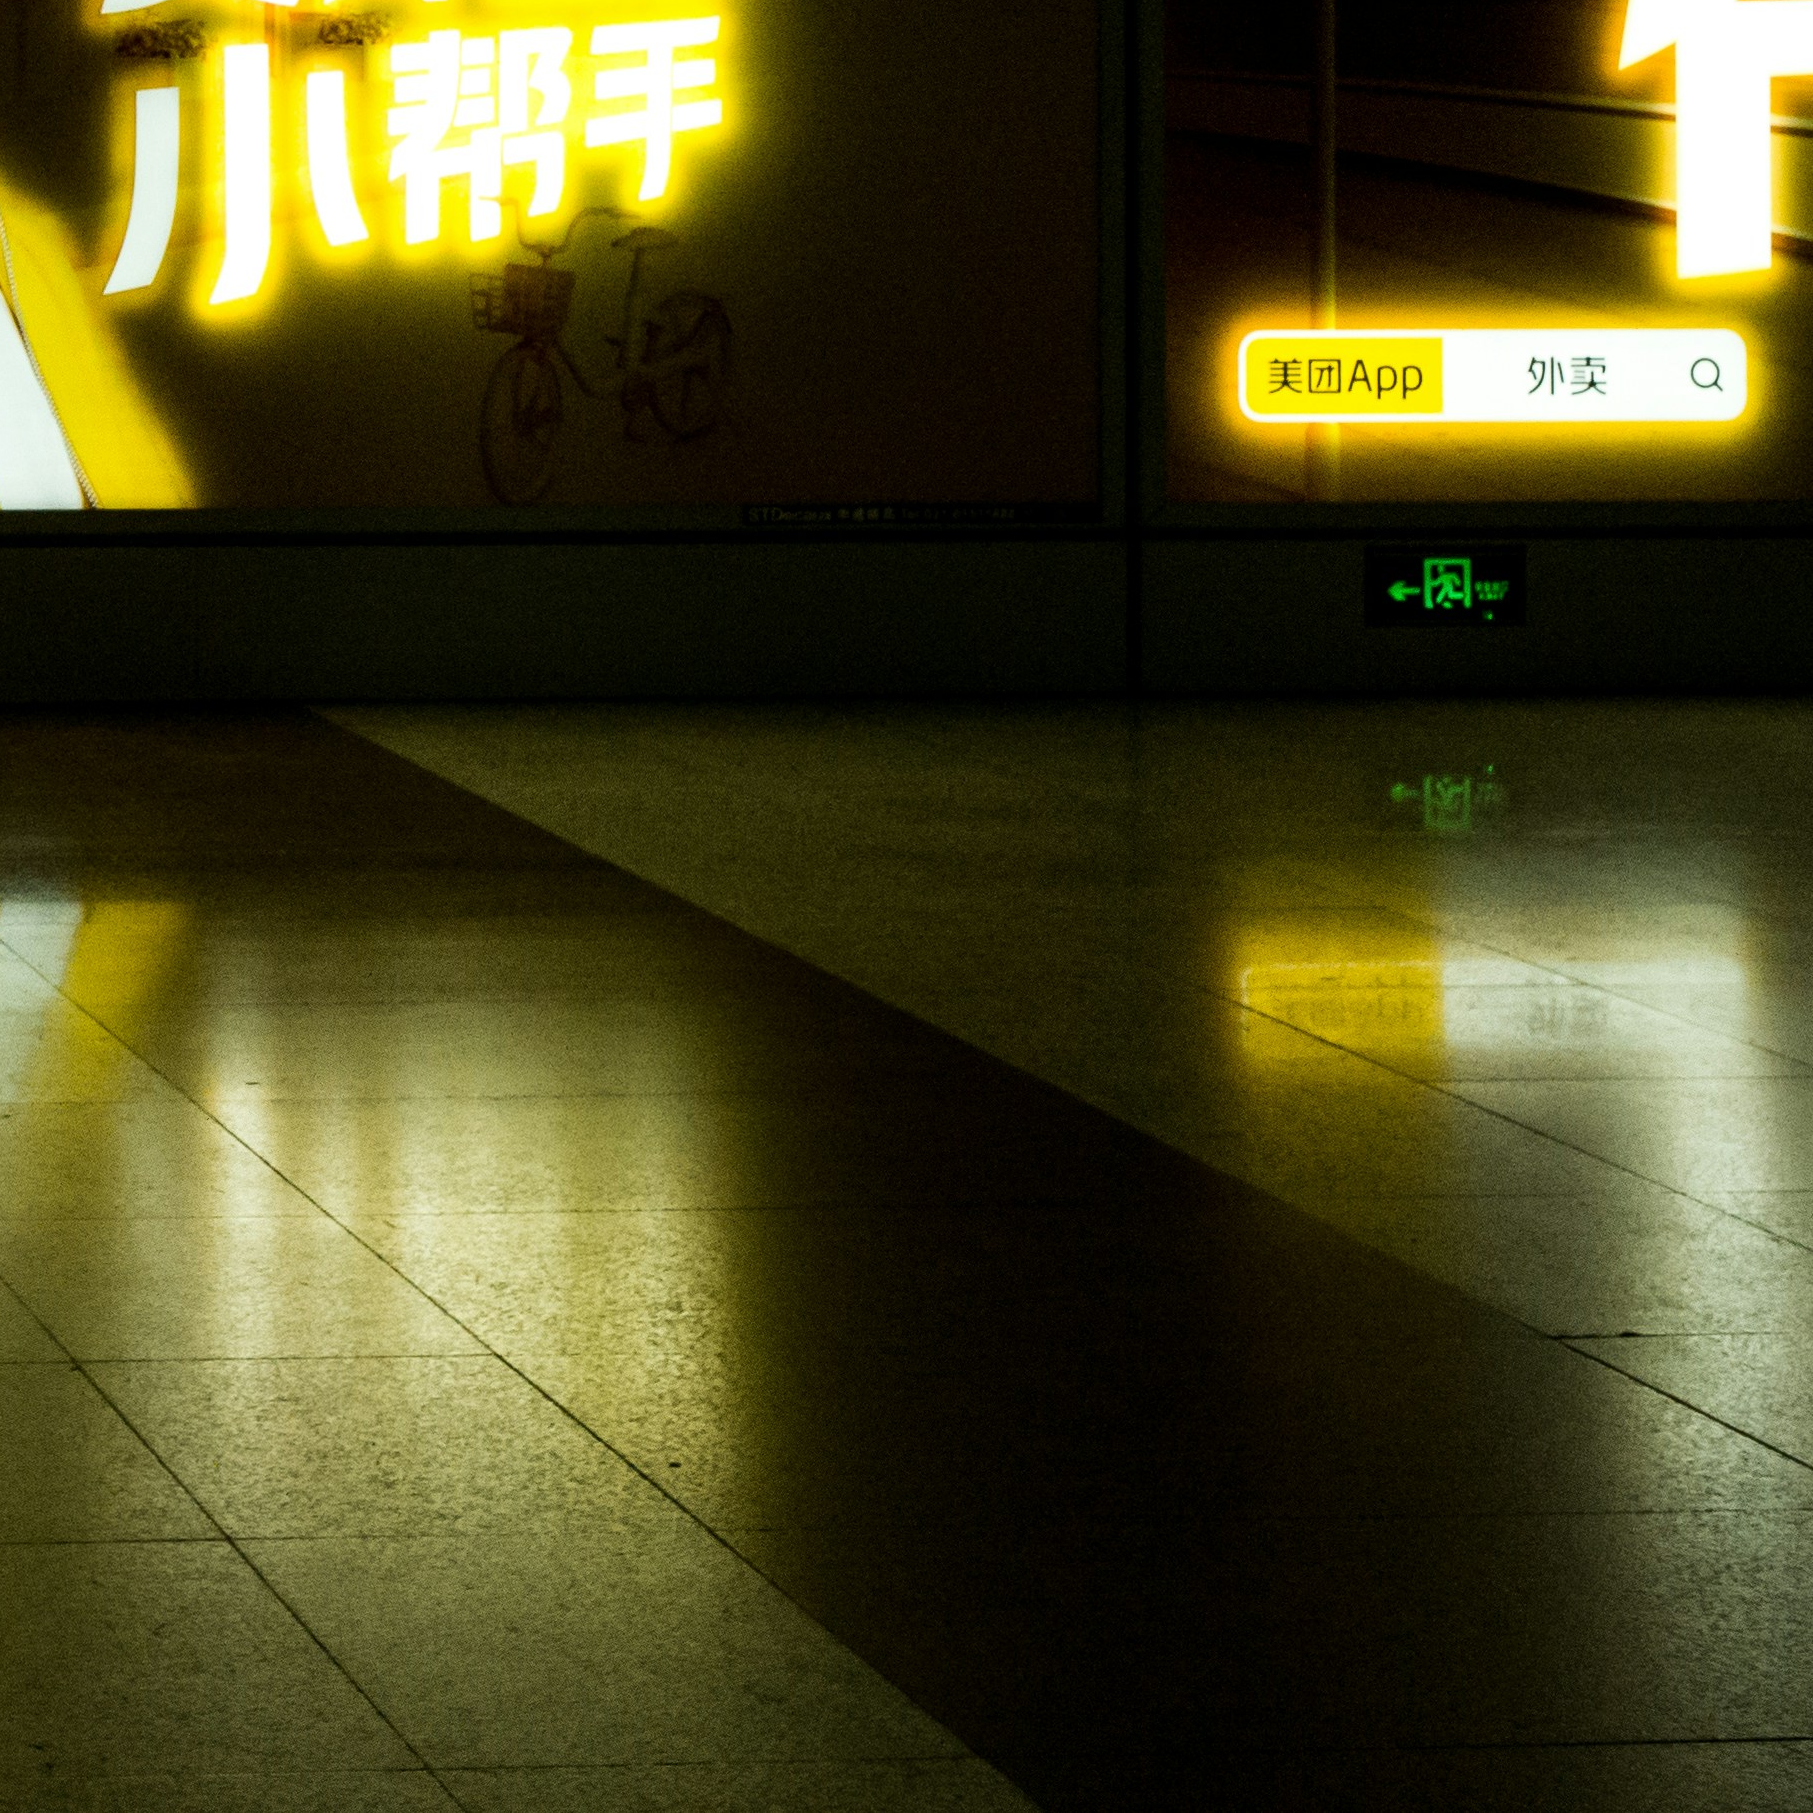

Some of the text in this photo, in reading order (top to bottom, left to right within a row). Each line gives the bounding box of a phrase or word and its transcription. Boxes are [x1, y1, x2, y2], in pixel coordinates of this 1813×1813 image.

[101, 15, 723, 306] 小帮手
[1268, 356, 1607, 400] 美团App 外卖
